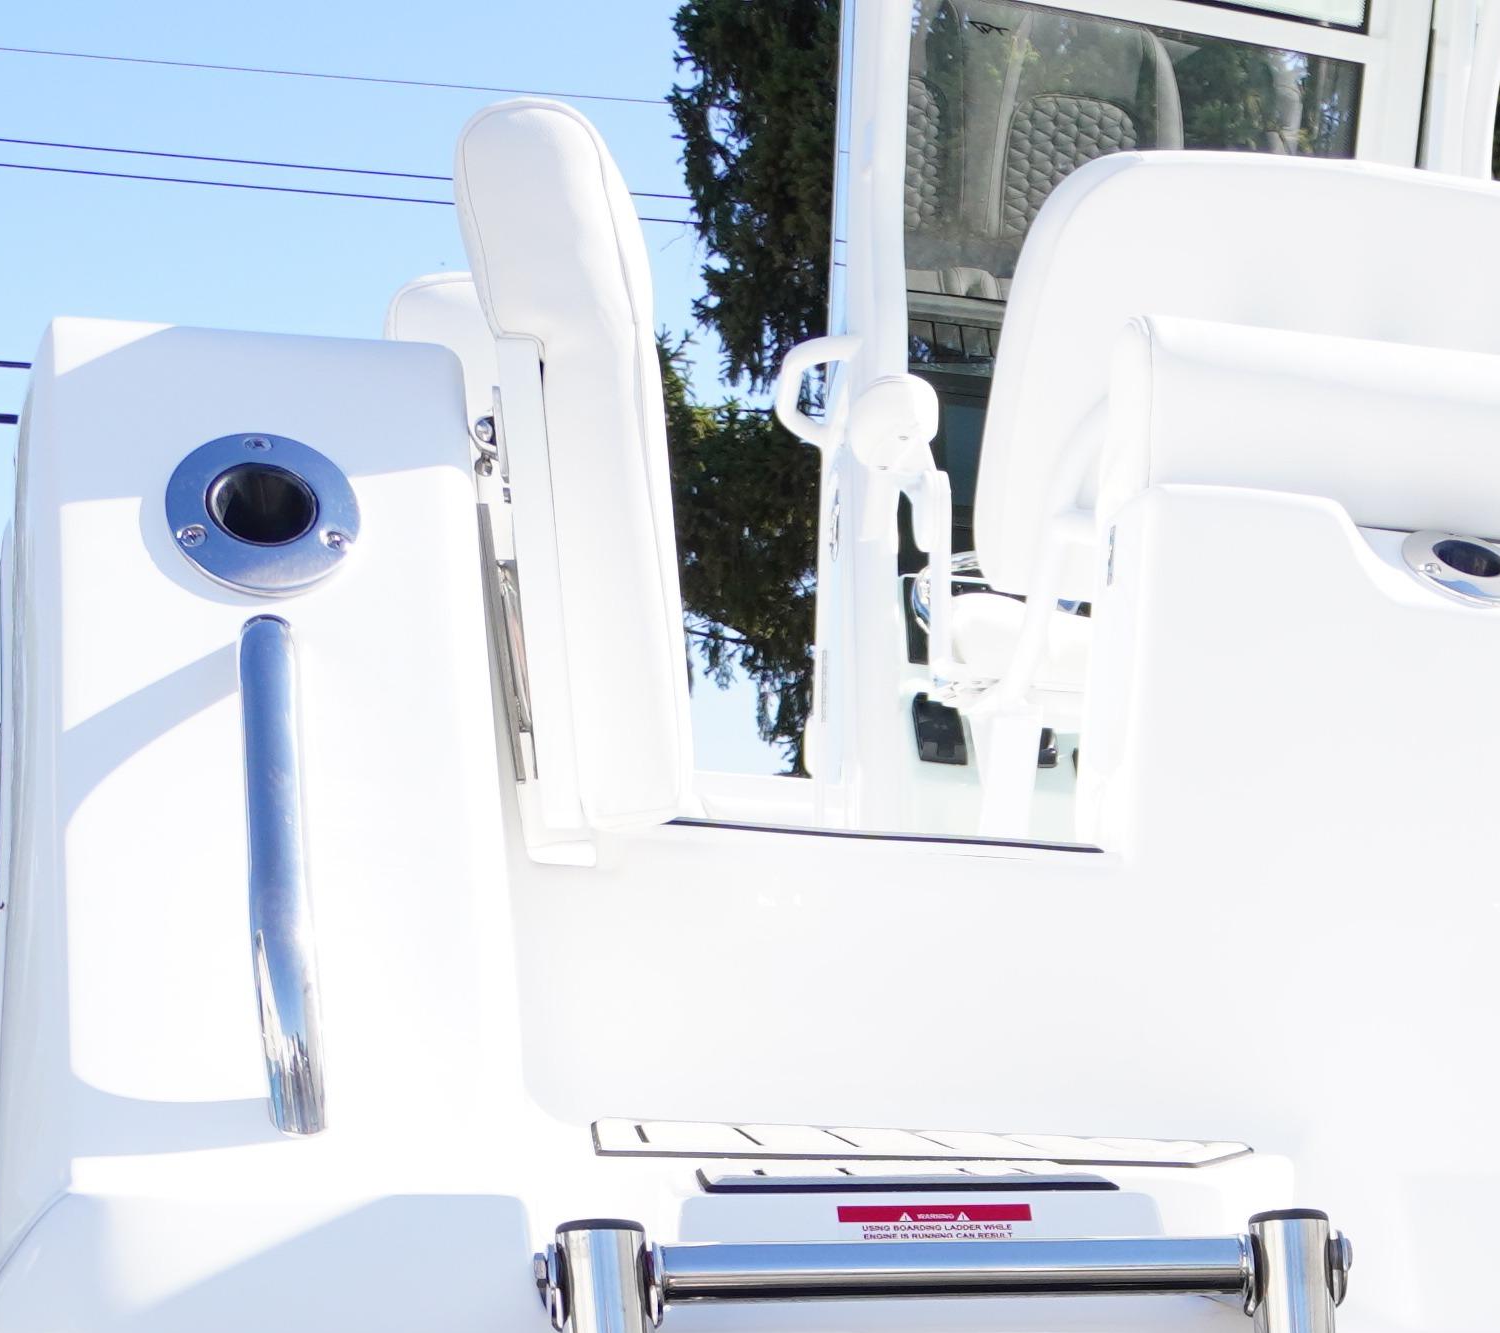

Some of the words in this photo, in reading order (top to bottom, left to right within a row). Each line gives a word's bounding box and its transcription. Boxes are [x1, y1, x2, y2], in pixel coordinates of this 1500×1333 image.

[862, 1224, 890, 1232] USING
[893, 1224, 943, 1232] BOARDING
[984, 1223, 1012, 1231] WHILE
